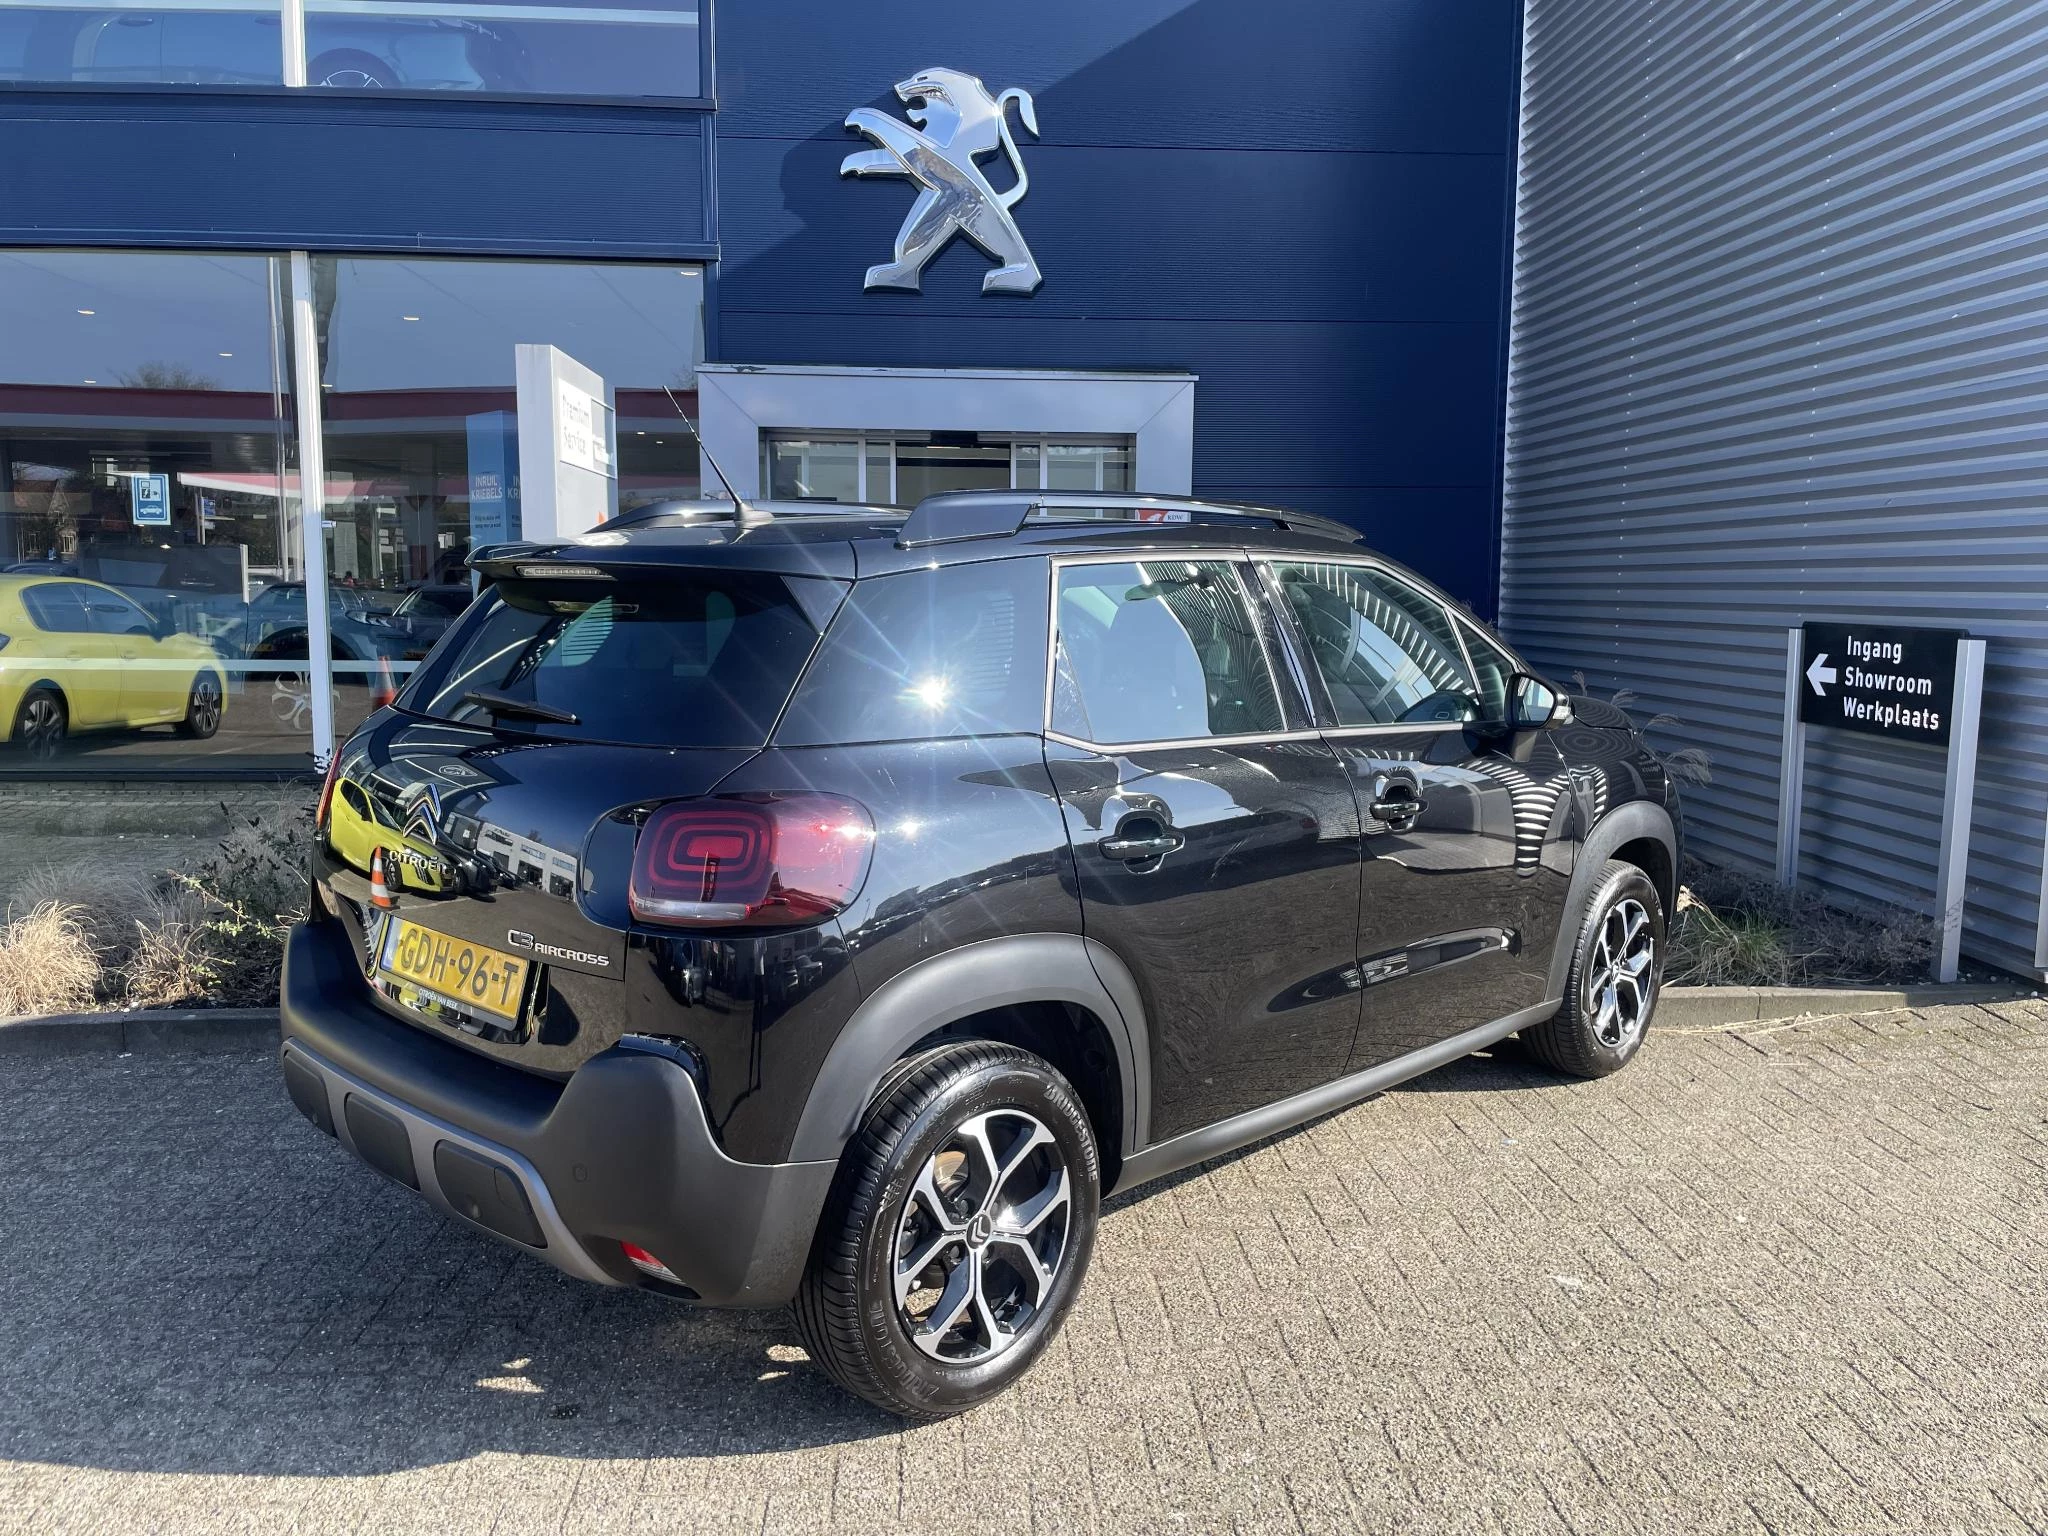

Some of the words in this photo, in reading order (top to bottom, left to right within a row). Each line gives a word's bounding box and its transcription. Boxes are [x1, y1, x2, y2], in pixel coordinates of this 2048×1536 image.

[471, 487, 503, 501] KRIEBELS
[475, 474, 498, 488] INRUIL
[1847, 635, 1902, 664] Ingang
[1844, 666, 1932, 695] Showroom
[1843, 696, 1939, 731] Werkplaats
[507, 929, 534, 950] C3
[534, 942, 610, 966] AIRCROSS
[400, 928, 519, 1006] GDH-96-T
[1043, 1082, 1098, 1183] BRIDGESTONE
